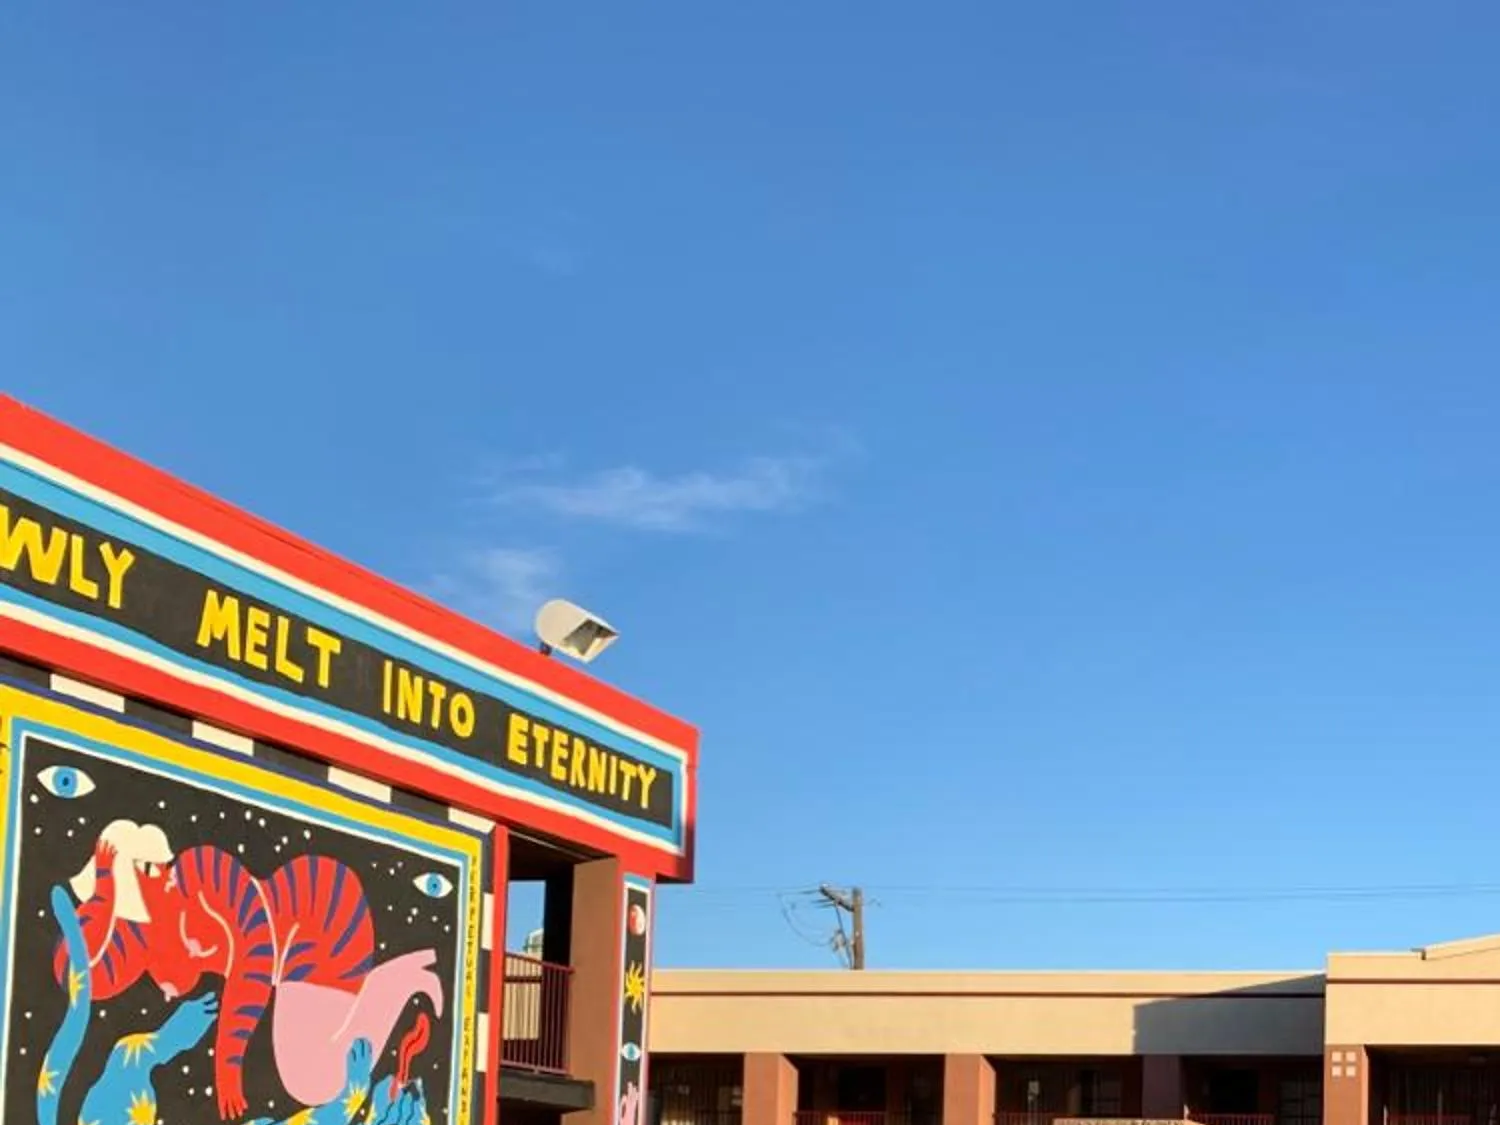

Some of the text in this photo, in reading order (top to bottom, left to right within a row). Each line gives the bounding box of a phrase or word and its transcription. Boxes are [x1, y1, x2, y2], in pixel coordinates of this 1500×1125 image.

[0, 503, 656, 809] WLY MELT INTO ETERNITY
